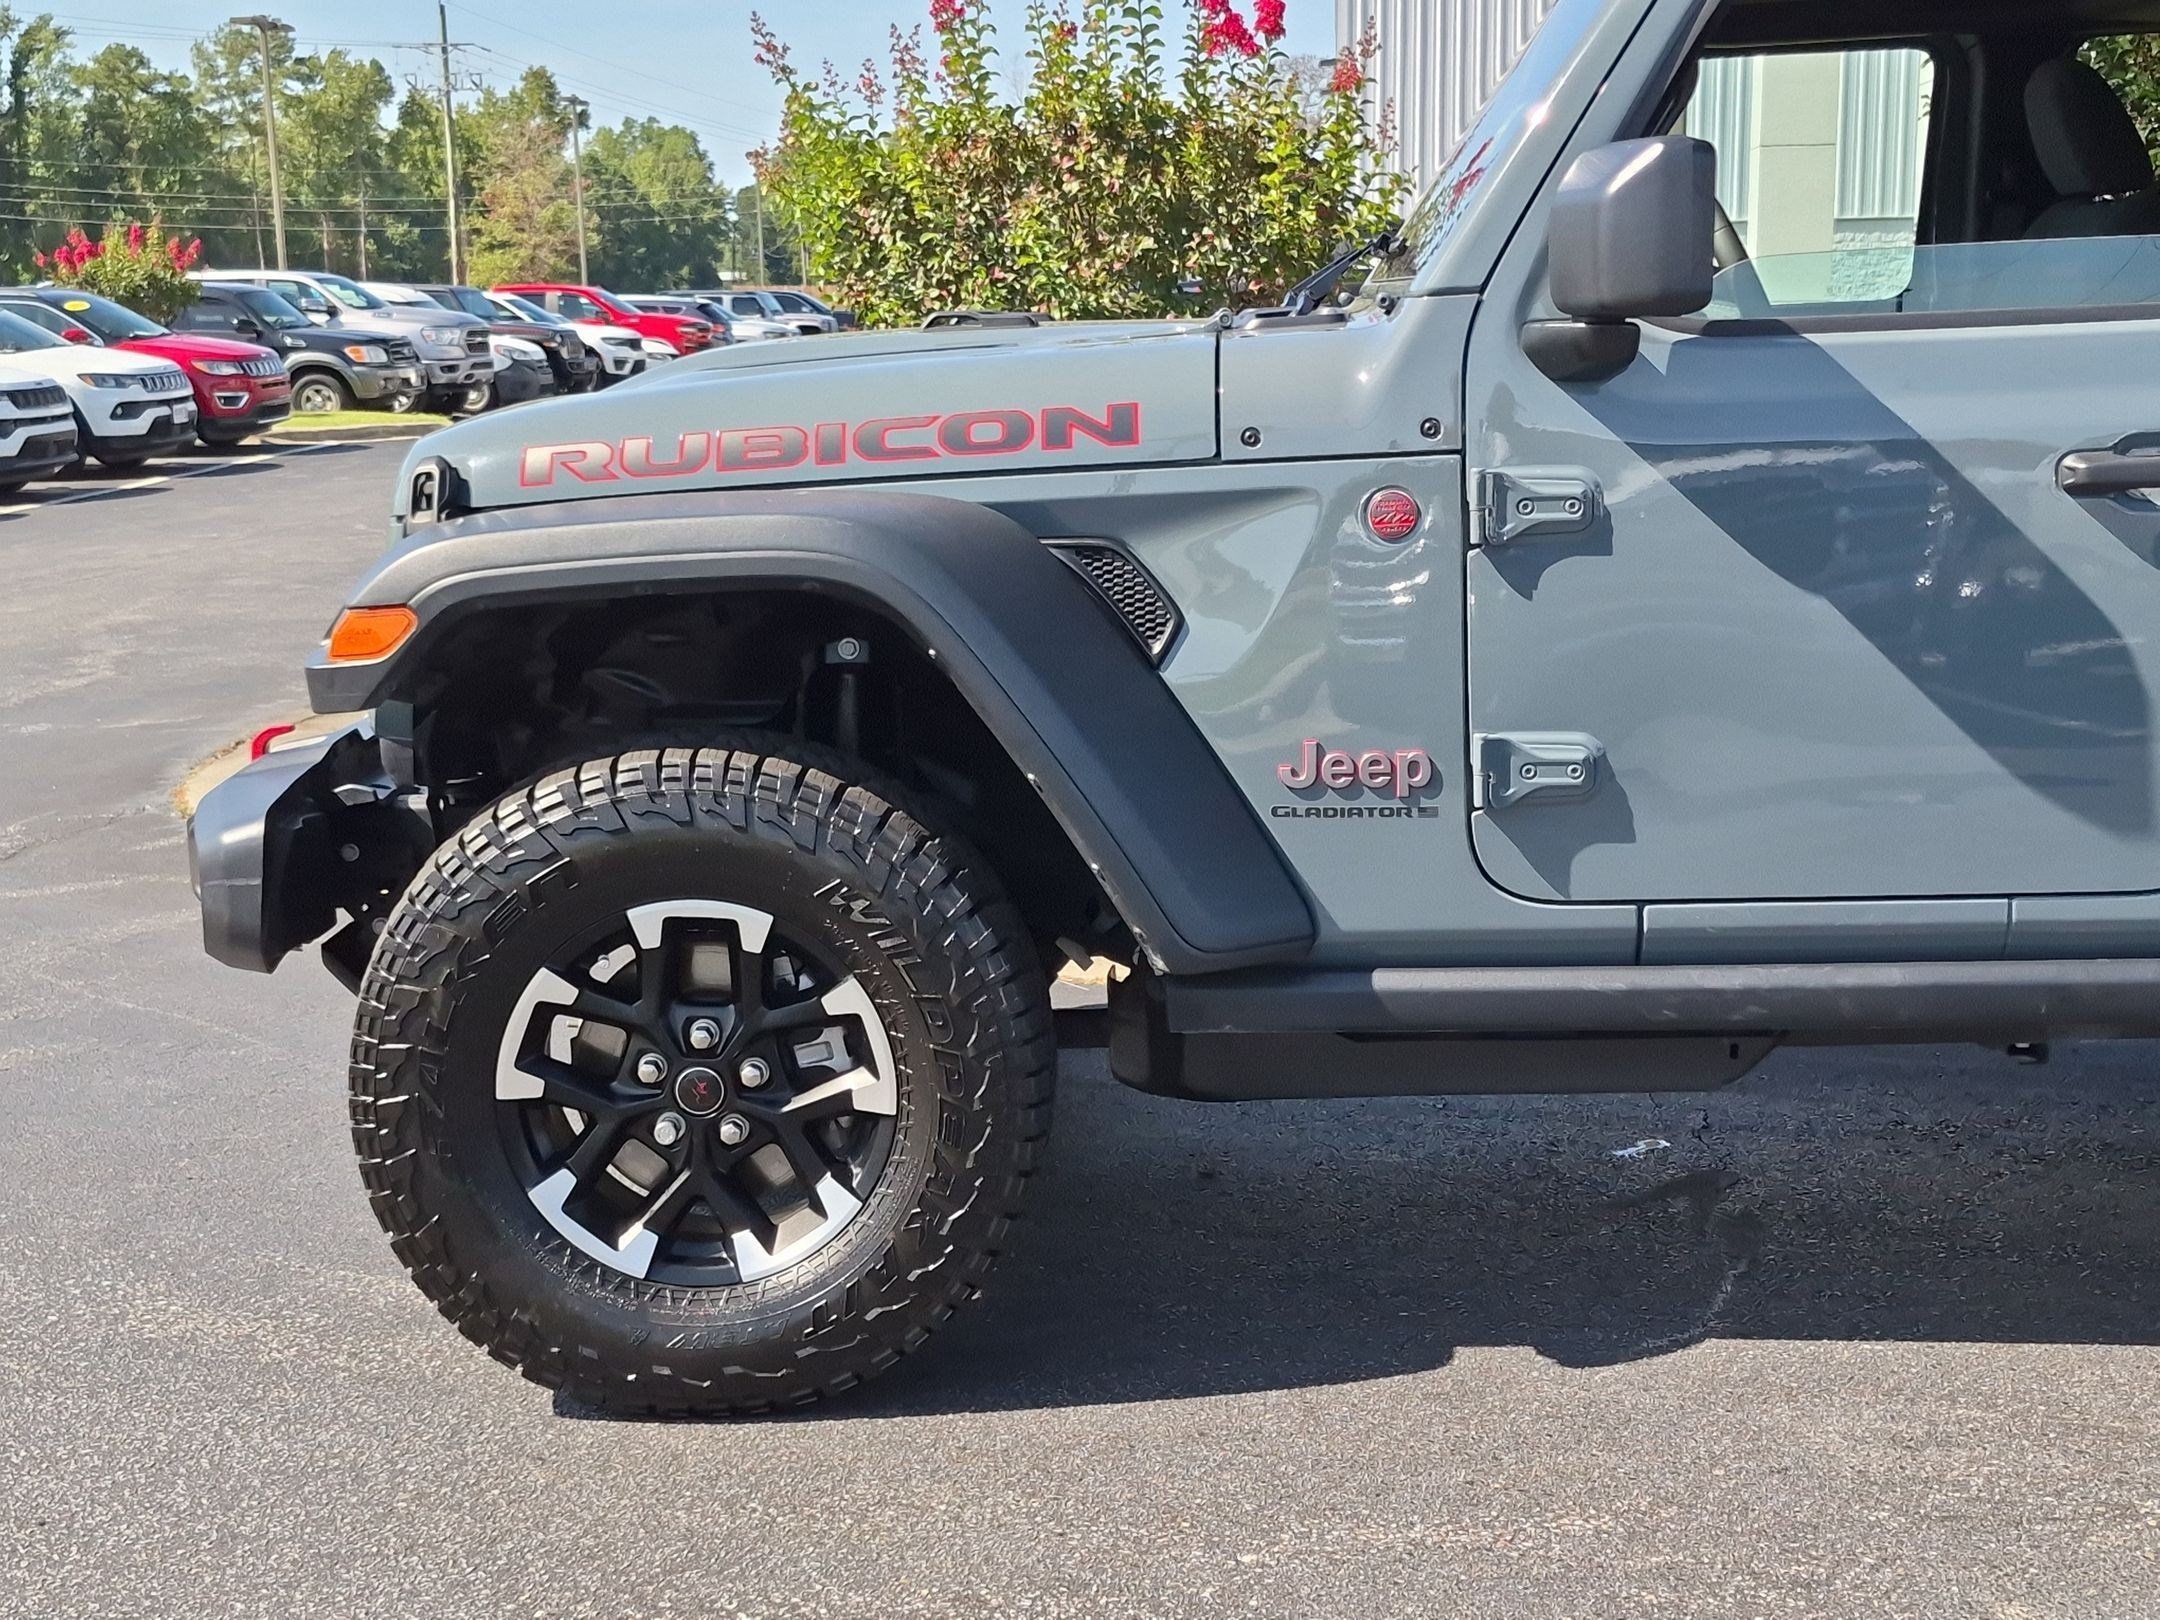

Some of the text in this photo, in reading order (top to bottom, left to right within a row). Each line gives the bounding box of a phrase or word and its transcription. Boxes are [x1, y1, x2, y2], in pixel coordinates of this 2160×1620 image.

[519, 402, 1140, 487] RUBICON
[1278, 739, 1433, 798] Jeep
[1270, 806, 1413, 819] GLADIATOR
[813, 876, 964, 1237] WILDPEAK
